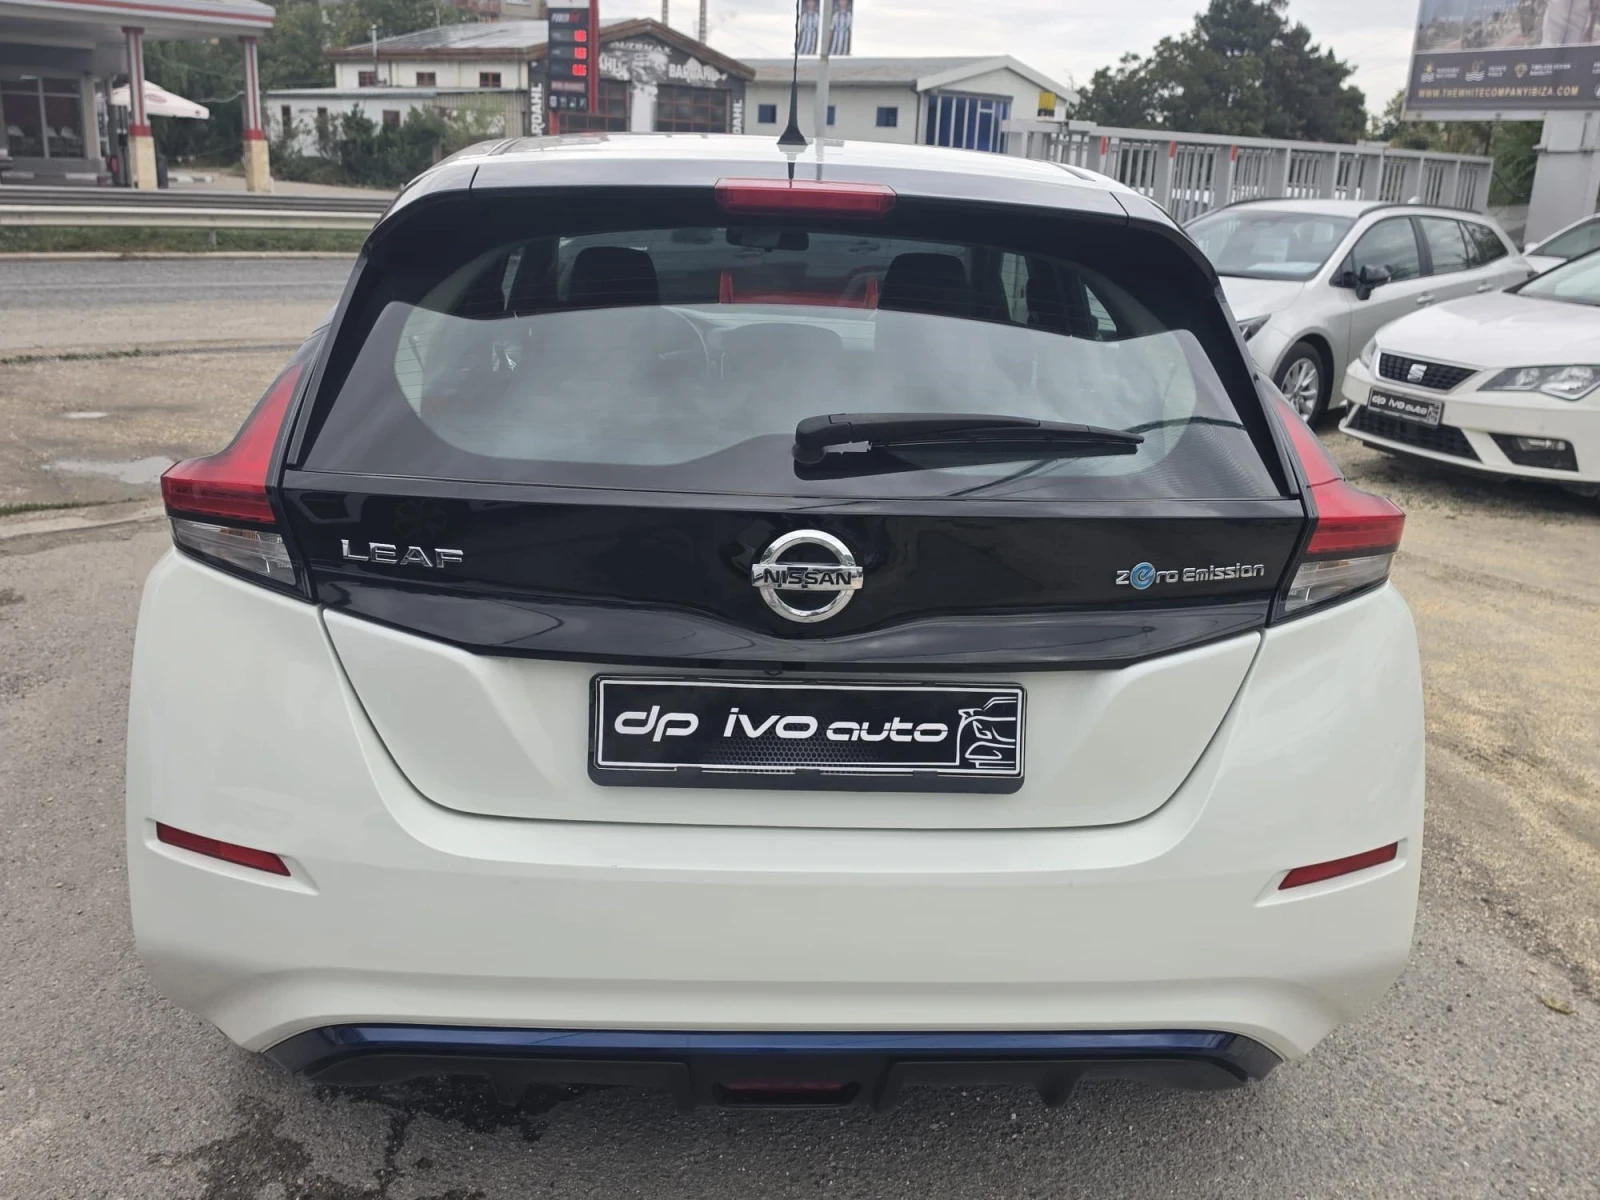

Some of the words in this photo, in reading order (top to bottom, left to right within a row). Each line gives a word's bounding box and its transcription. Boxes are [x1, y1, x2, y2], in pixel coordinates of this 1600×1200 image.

[530, 83, 546, 136] RDAHL
[340, 539, 464, 568] LEAF
[763, 568, 852, 585] NISSAN
[1182, 562, 1265, 583] Emission
[614, 705, 699, 742] dp
[723, 708, 818, 739] ivo
[826, 717, 948, 743] auto
